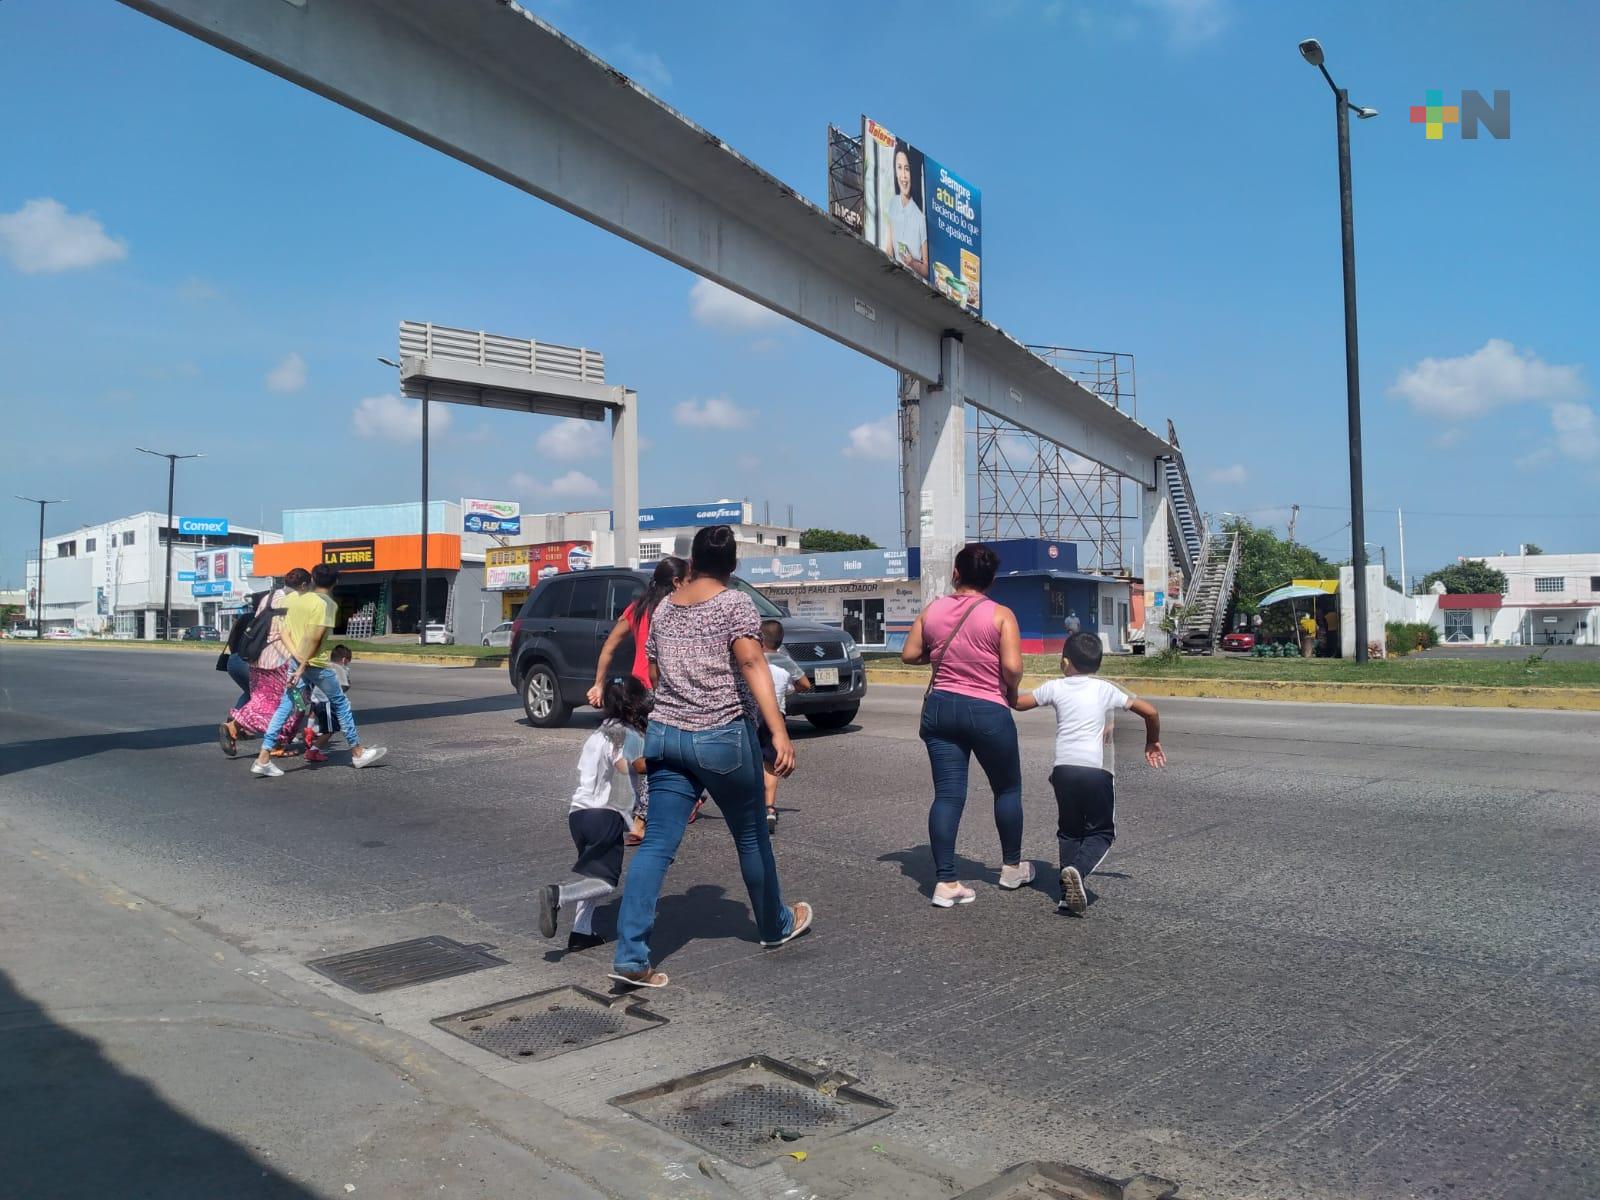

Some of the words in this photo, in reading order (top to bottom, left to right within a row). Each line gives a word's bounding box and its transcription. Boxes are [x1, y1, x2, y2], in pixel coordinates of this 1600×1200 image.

[940, 168, 971, 200] Siempre
[932, 198, 959, 225] haciendo
[955, 193, 975, 220] lado
[938, 217, 945, 231] te
[696, 508, 740, 519] GOODYEAR
[183, 520, 225, 532] Comex
[325, 553, 337, 564] LA
[340, 551, 373, 563] FERRE
[808, 585, 827, 594] PARA
[828, 584, 838, 593] EL
[839, 583, 878, 593] SOLDADOR
